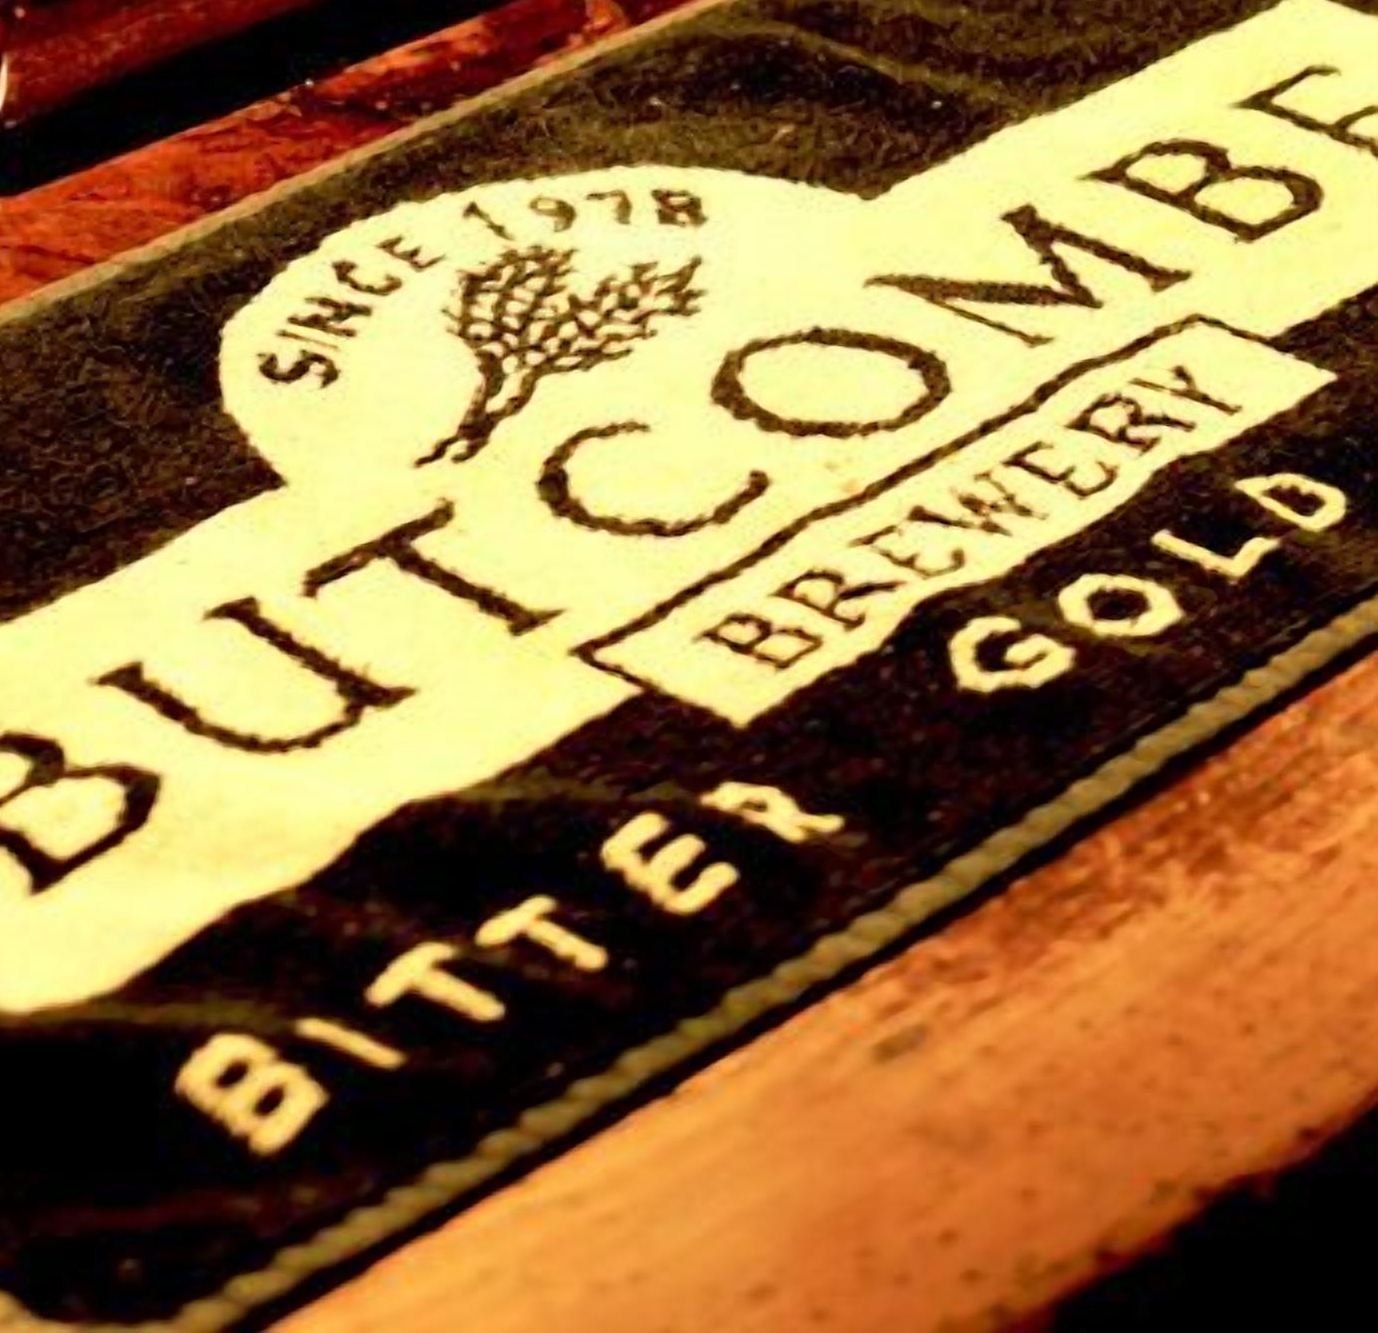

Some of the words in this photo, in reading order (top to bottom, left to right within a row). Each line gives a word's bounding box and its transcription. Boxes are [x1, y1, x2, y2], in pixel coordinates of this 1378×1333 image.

[258, 234, 447, 389] SINCE
[462, 188, 709, 241] 1978
[696, 365, 1244, 672] BREWERY
[175, 780, 844, 1156] BITTER
[949, 471, 1349, 693] GOLD
